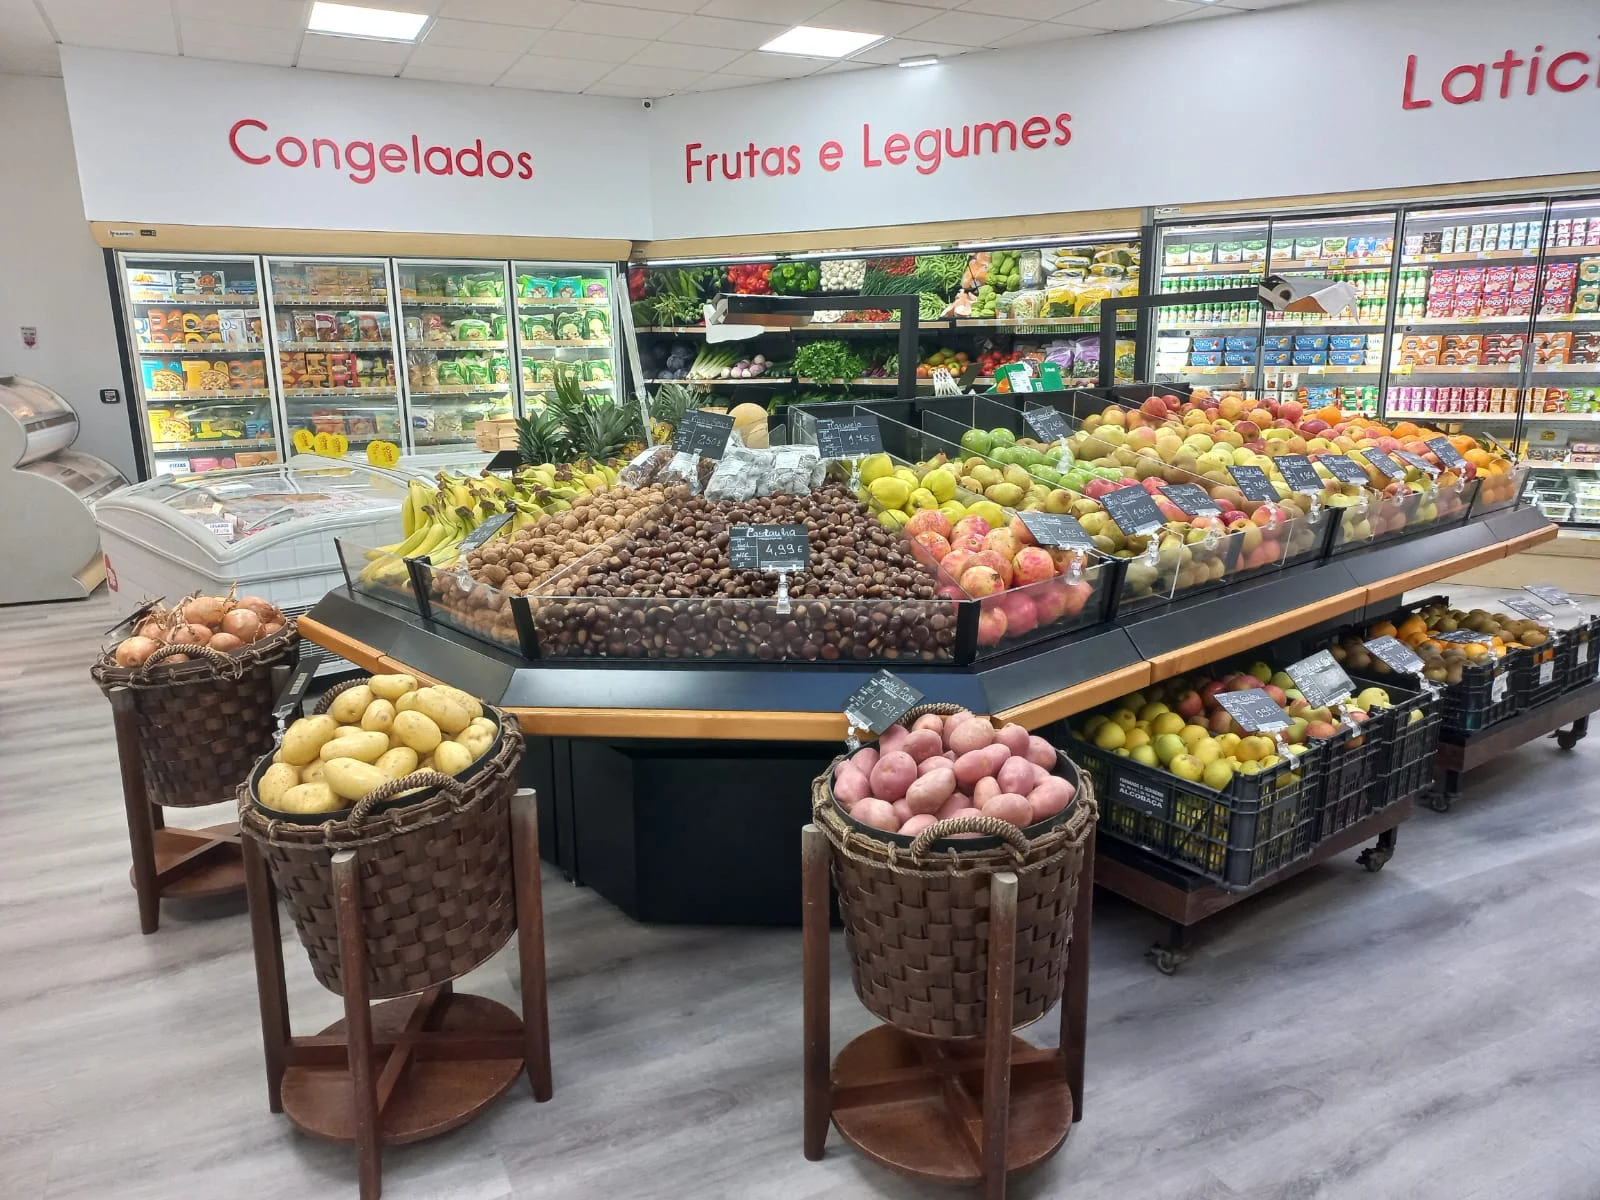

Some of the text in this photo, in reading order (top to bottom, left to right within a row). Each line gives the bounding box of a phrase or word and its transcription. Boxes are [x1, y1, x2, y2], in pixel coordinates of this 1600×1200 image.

[229, 117, 534, 185] Congelados
[685, 112, 1072, 183] Frutas e Legumes
[1518, 270, 1537, 281] Yogg
[1119, 787, 1163, 809] ALCOBAÇA
